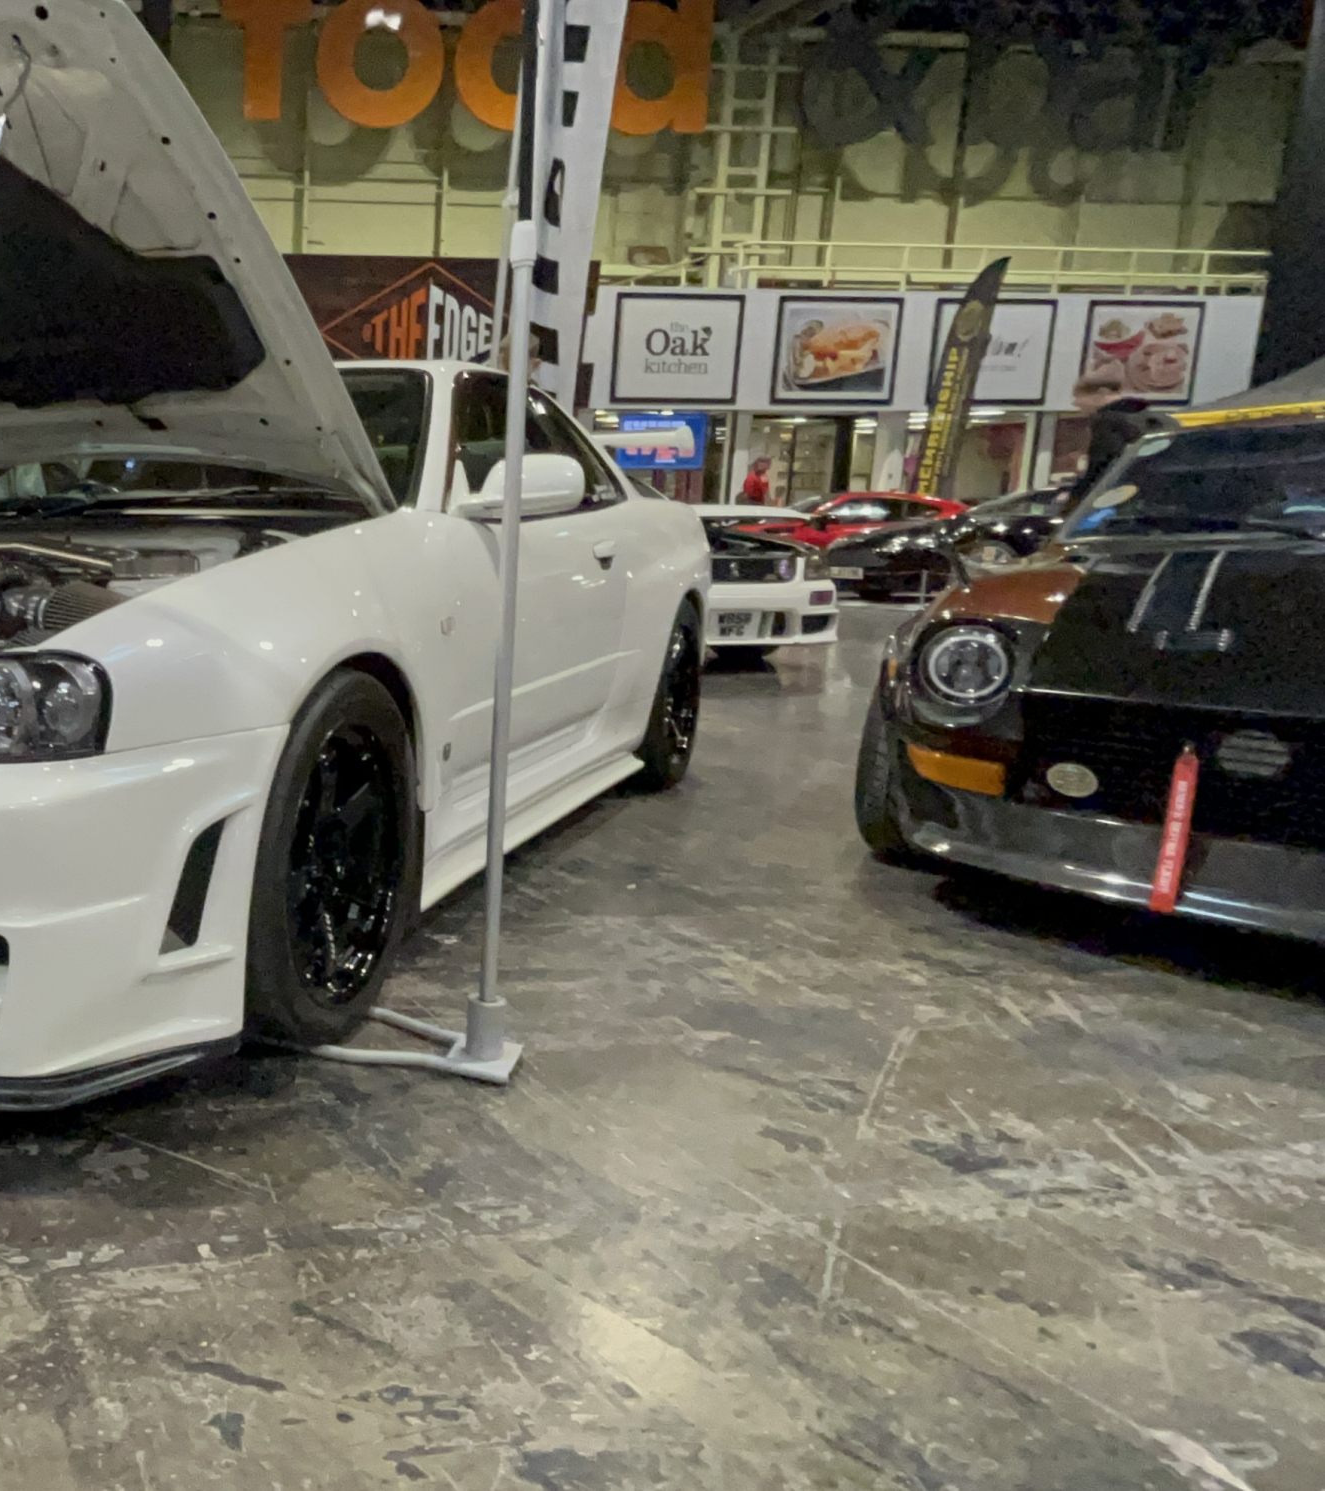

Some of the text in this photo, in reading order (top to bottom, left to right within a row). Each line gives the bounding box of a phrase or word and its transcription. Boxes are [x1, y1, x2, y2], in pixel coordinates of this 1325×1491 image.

[371, 283, 494, 361] THE EDGE
[645, 327, 711, 357] Oak
[644, 358, 709, 375] kitchen
